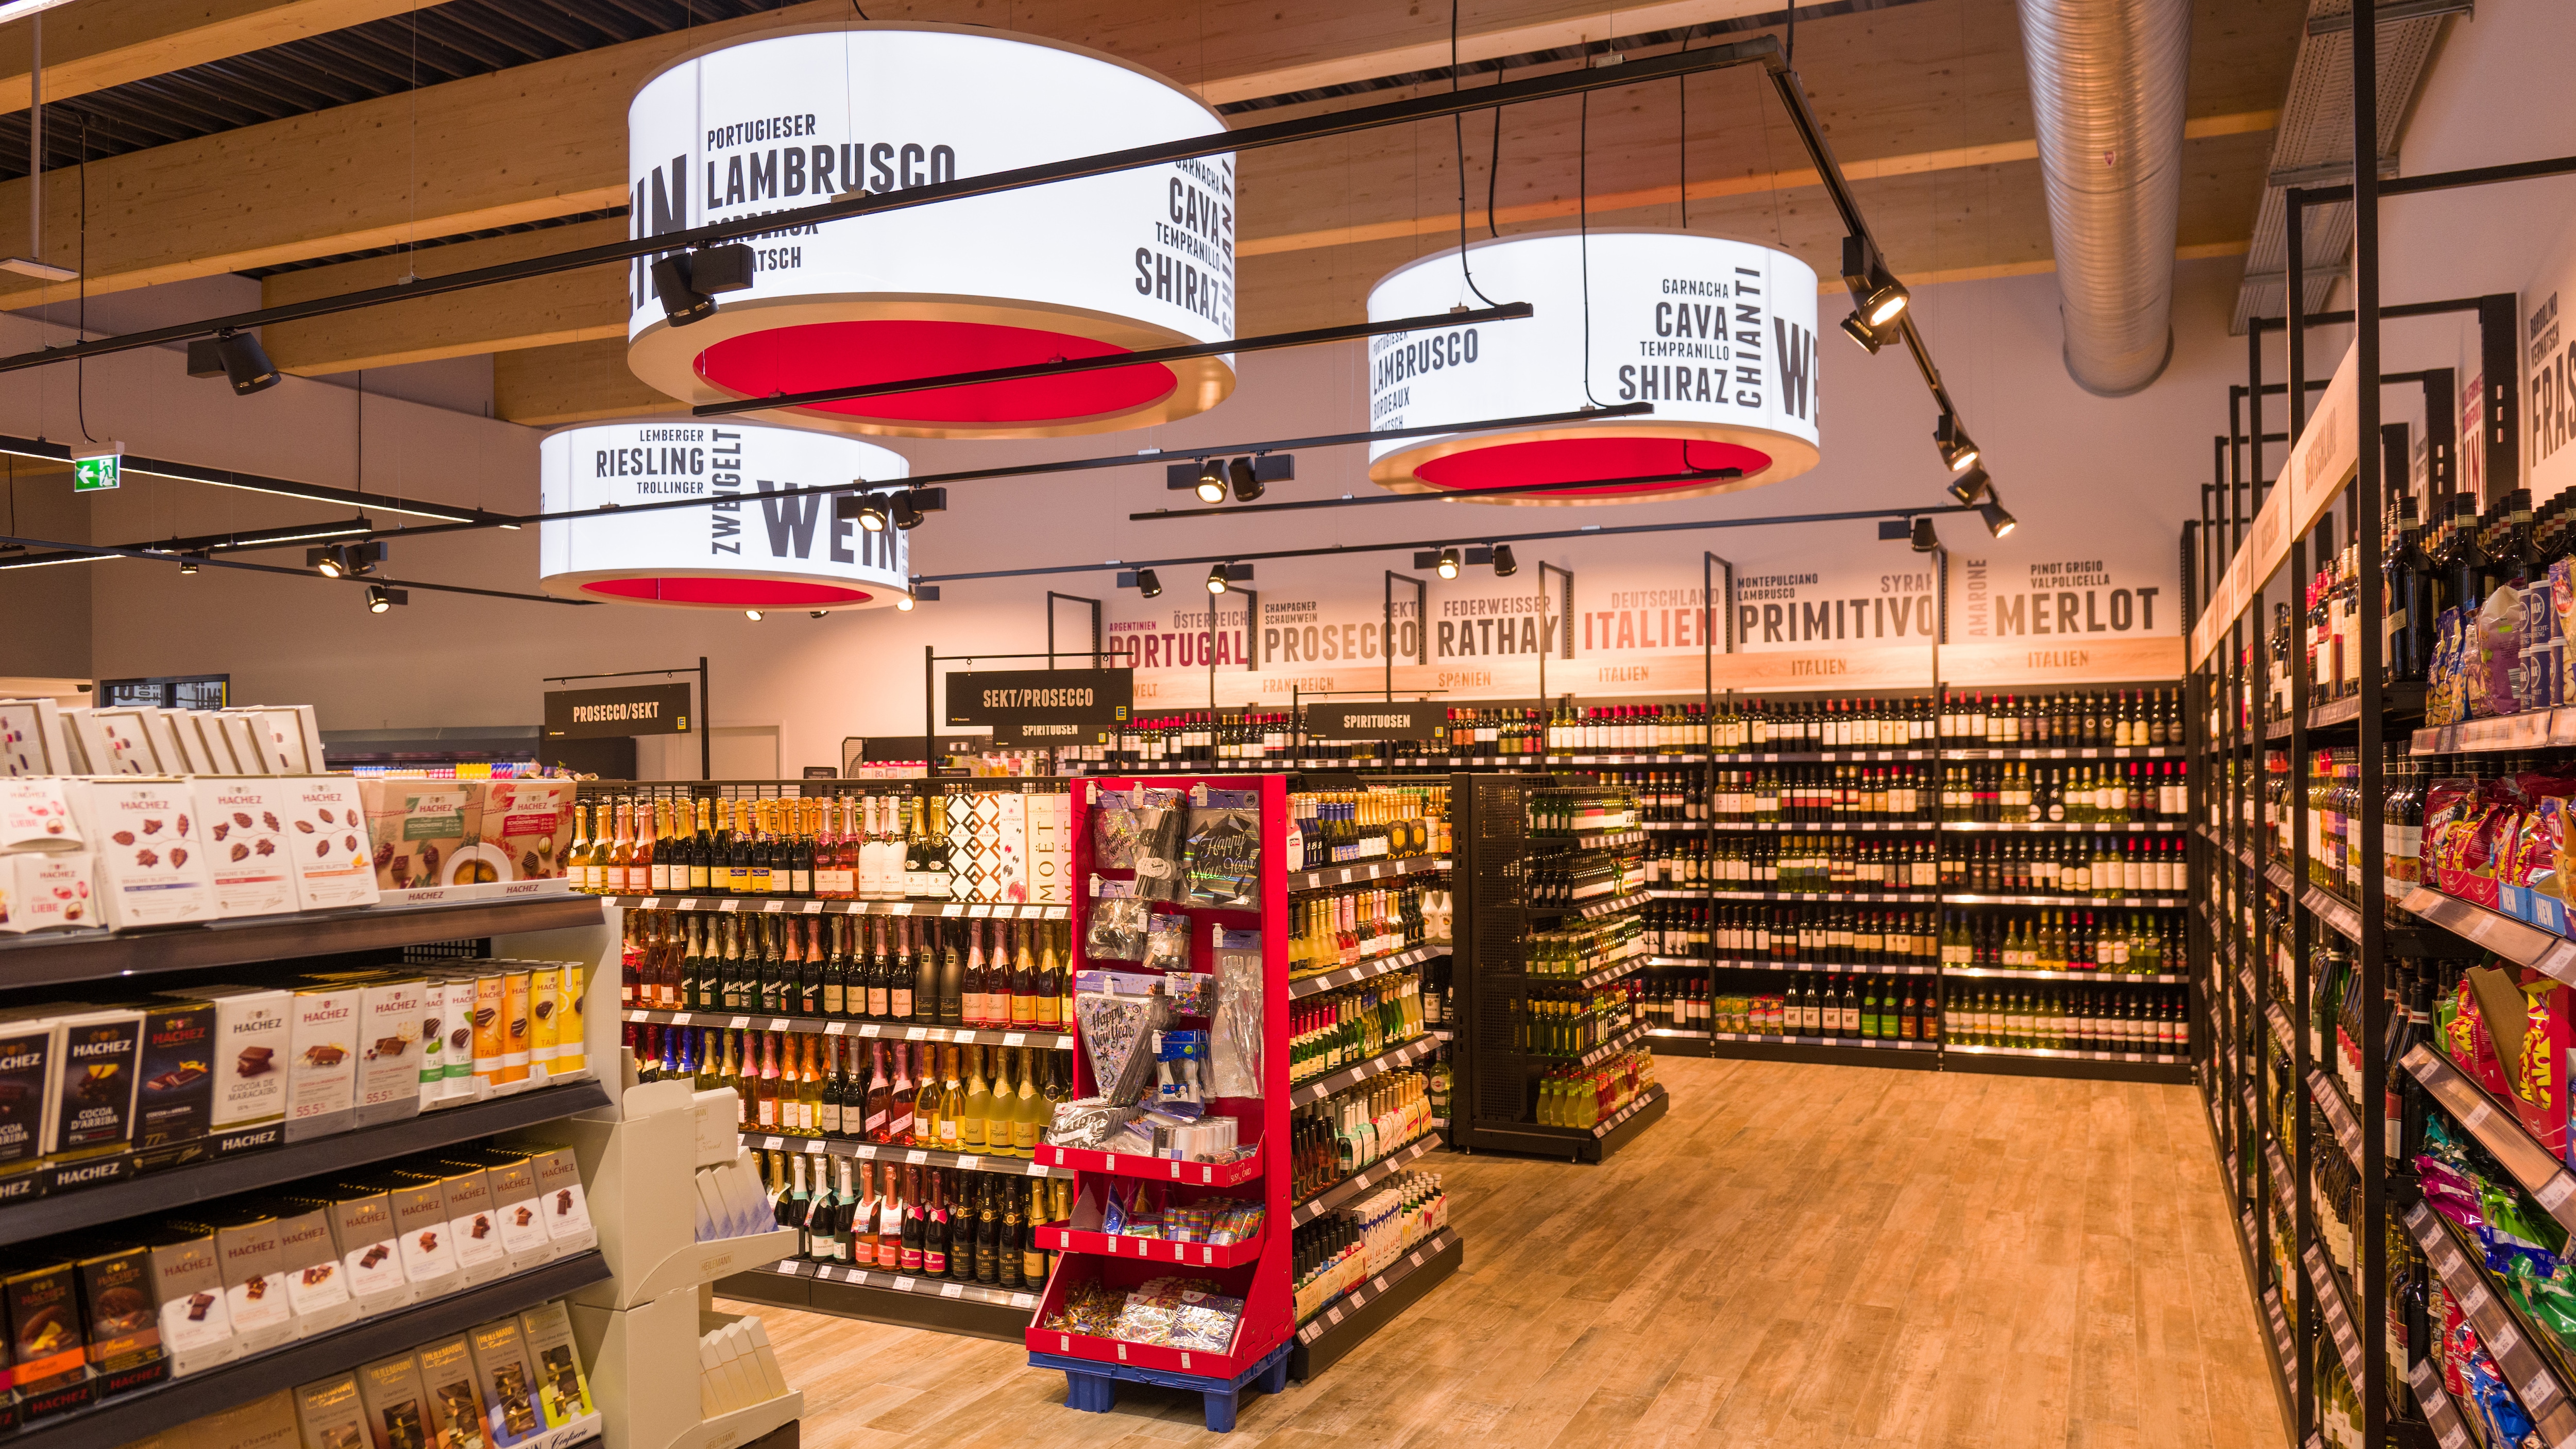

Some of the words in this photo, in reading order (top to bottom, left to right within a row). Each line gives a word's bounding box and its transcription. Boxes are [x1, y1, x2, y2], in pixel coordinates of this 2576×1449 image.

[708, 114, 816, 151] PORTUGIESER
[708, 142, 955, 210] LAMBRUSCO
[1170, 177, 1219, 248] CAVA
[1156, 221, 1219, 272] TEMPRANILLO
[1222, 158, 1231, 338] CHIANTI
[1136, 247, 1219, 326] SHIRAZ
[1662, 278, 1729, 299] GARNACHA
[1656, 301, 1728, 341] CAVA
[1735, 266, 1761, 408] CHIANTI
[2531, 320, 2560, 370] VERNATSCH
[1640, 341, 1730, 361] TEMPRANILLO
[1374, 328, 1478, 396] LAMBRUSCO
[1619, 364, 1728, 404] SHIRAZ
[1374, 386, 1410, 422] BORDEAUX
[640, 429, 704, 442] LEMBERGER
[596, 447, 704, 478] RIESLING
[637, 481, 704, 494] TROLLINGER
[2030, 562, 2063, 575] PINOT
[2065, 560, 2103, 573] GRIGIO
[1737, 573, 1819, 588] MONTEPULCIANO
[2030, 573, 2110, 588] VALPOLICELLA
[1612, 588, 1720, 609] DEUTSCHLAND
[1737, 586, 1795, 601] LAMBRUSCO
[1968, 559, 1987, 637] AMARONE
[1265, 601, 1317, 613] CHAMPAGNER
[1444, 596, 1551, 617] FEDERWEISSER
[1995, 587, 2159, 637] MERLOT
[1109, 621, 1157, 632] ARGENTINIEN
[1265, 612, 1317, 625] SCHAUMWEIN
[1739, 595, 1934, 644] PRIMITIVO
[1585, 608, 1718, 650] ITALIEN
[1109, 630, 1248, 668] PORTUGAL
[1265, 620, 1418, 663] PROSECCO
[1792, 658, 1846, 676] ITALIEN
[2028, 650, 2089, 668] ITALIEN
[1438, 671, 1491, 687] SPANIEN
[1599, 666, 1649, 683] ITALIEN
[1263, 677, 1334, 693] FRANKREICH
[983, 688, 1094, 708] SEKT/PROSECCO
[573, 701, 659, 722] PROSECCO/SEKT
[1117, 707, 1125, 716] E
[1344, 714, 1411, 729] SPIRITUOSEN
[120, 801, 170, 810] HACHEZ
[218, 796, 262, 804] HACHEZ
[302, 793, 342, 802] HACHEZ
[517, 802, 548, 811] HACHEZ
[419, 804, 452, 813] HACHEZ
[1106, 827, 1122, 847] Happy
[1199, 833, 1247, 858] Happy
[1109, 845, 1119, 857] New
[1117, 836, 1131, 852] Year
[1036, 820, 1055, 902] MOËT
[1187, 860, 1222, 882] New
[1223, 855, 1257, 880] Year
[40, 870, 76, 879] HACHEZ
[408, 891, 444, 901] HACHEZ
[506, 884, 539, 894] HACHEZ
[2501, 883, 2517, 914] NEW
[31, 903, 59, 914] LIEBE
[2535, 896, 2554, 927] NEW
[303, 1008, 349, 1023] HACHEZ
[376, 1000, 417, 1014] HACHEZ
[233, 1018, 283, 1034] HACHEZ
[1090, 1004, 1126, 1031] Happy
[152, 1027, 206, 1044] HACHEZ
[1092, 1031, 1111, 1051] New
[1110, 1023, 1134, 1049] Year
[73, 1039, 132, 1057] HACHEZ
[227, 1086, 278, 1102] MARACAIBO
[232, 1081, 261, 1093] COCOA
[263, 1079, 275, 1087] DE
[79, 1107, 113, 1120] COCOA
[71, 1115, 119, 1131] D'ARRIBA
[222, 1130, 277, 1151] HACHEZ
[57, 1161, 121, 1186] HACHEZ
[541, 1163, 575, 1178] HACHEZ
[1230, 1172, 1240, 1183] SUSY
[1242, 1168, 1251, 1177] CARD
[497, 1177, 532, 1192] HACHEZ
[451, 1187, 487, 1204] HACHEZ
[401, 1200, 440, 1217] HACHEZ
[346, 1211, 388, 1228] HACHEZ
[282, 1227, 326, 1246] HACHEZ
[228, 1240, 275, 1259] HACHEZ
[164, 1257, 213, 1277] HACHEZ
[701, 1254, 732, 1272] HEILEMANN
[479, 1326, 515, 1344] HEILEMANN
[424, 1343, 463, 1362] HEILEMANN
[110, 1366, 162, 1390] HACHEZ
[32, 1388, 88, 1413] HACHEZ
